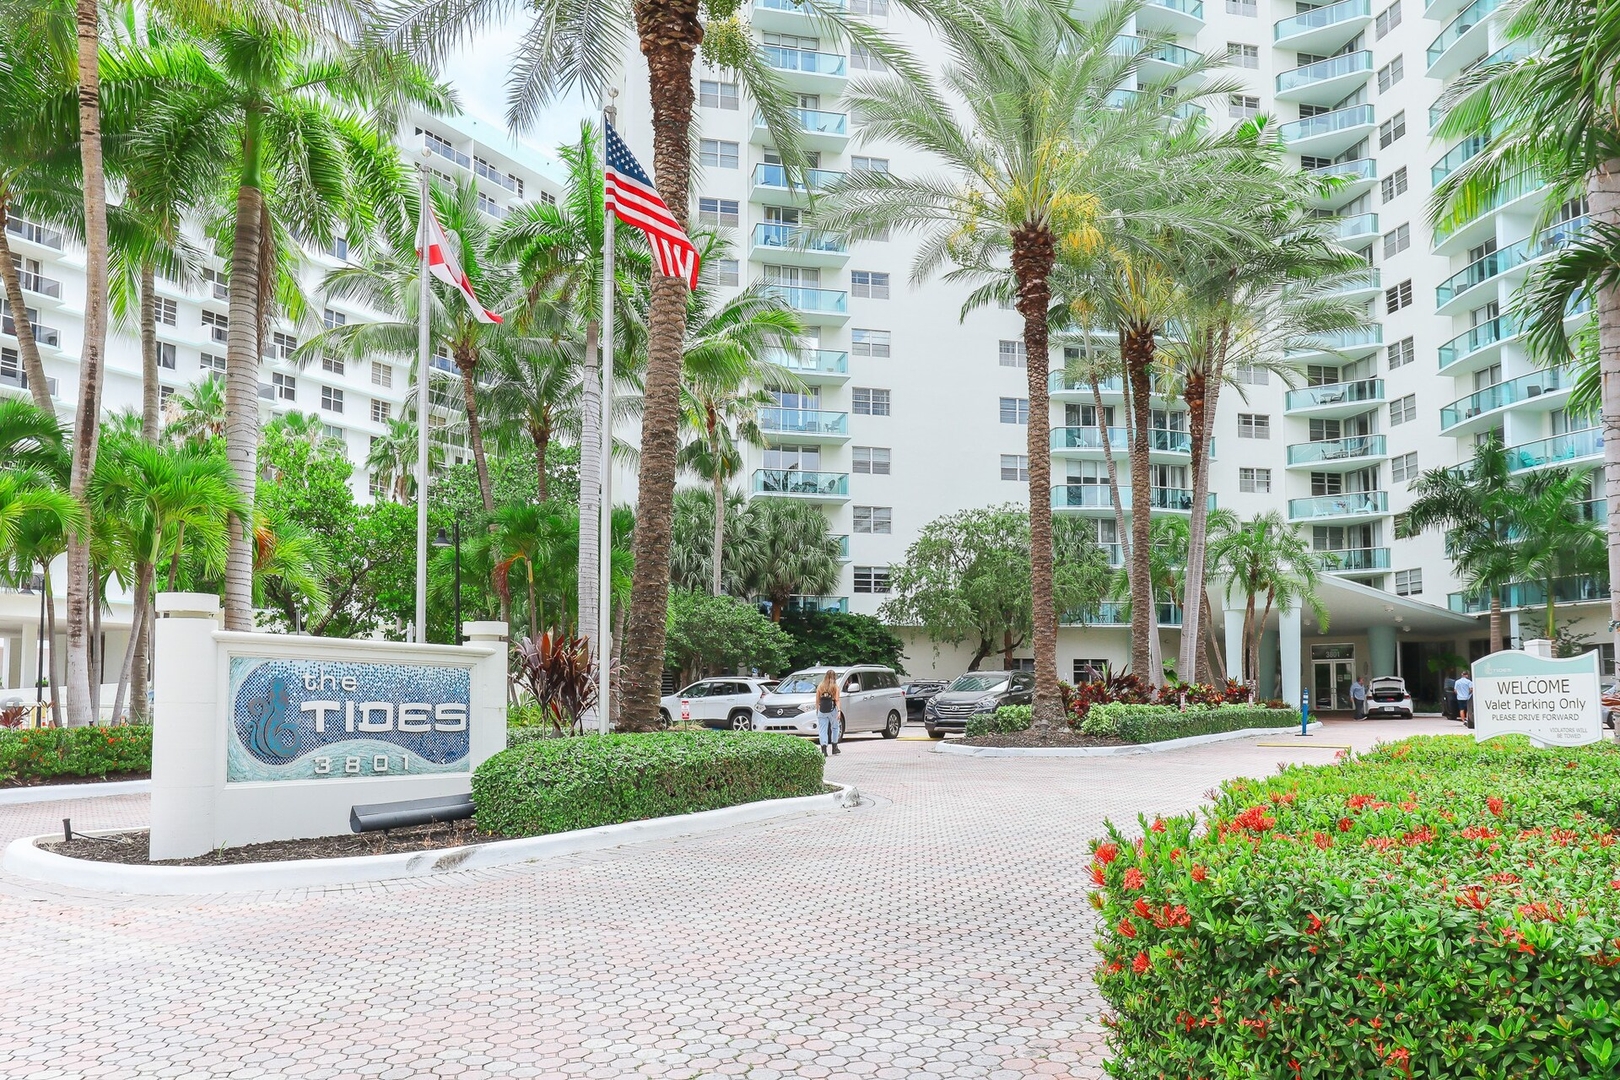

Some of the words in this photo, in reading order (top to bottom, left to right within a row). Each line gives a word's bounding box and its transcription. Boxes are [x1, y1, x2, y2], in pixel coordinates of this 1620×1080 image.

[302, 670, 358, 691] the
[1497, 679, 1570, 695] WELCOME
[1485, 699, 1511, 710] Valet
[1515, 698, 1555, 712] Parking
[1559, 698, 1586, 711] Only
[301, 700, 467, 733] TIDES
[1542, 713, 1580, 721] FORWARD
[314, 754, 409, 774] 3801
